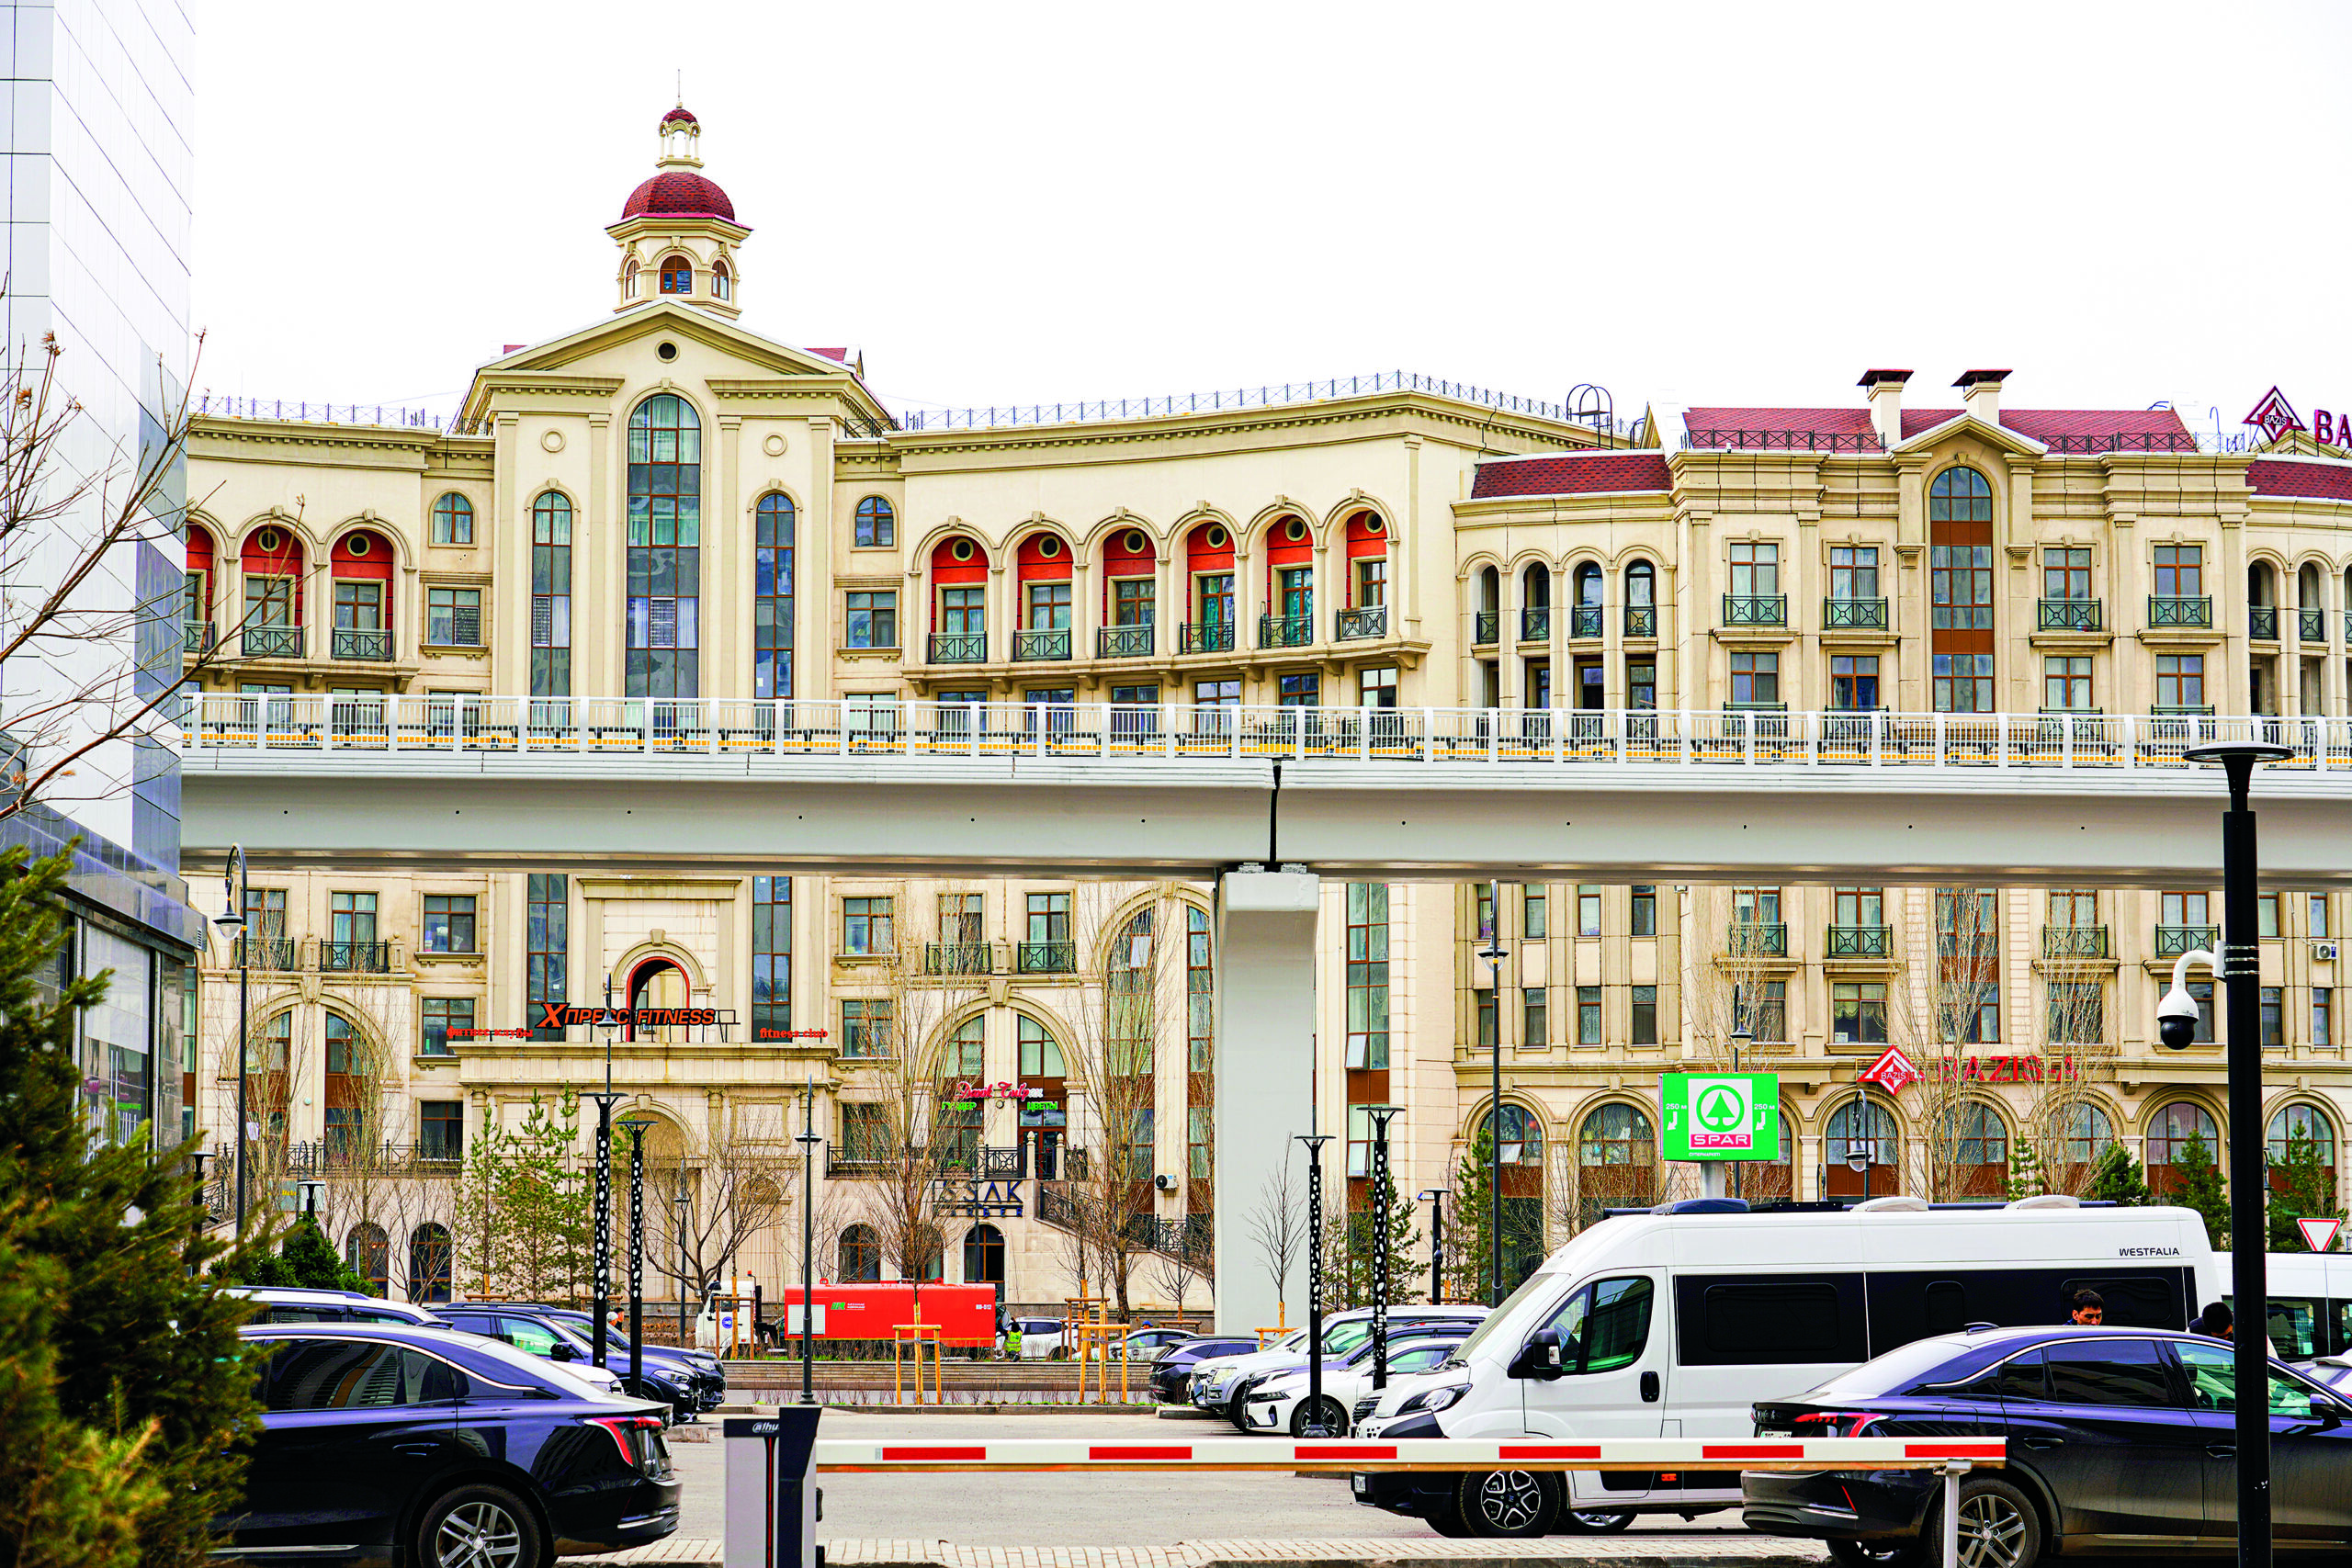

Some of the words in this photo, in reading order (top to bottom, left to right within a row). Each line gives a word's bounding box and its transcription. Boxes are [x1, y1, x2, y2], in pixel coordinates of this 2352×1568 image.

[2265, 414, 2287, 425] BAZIS
[2314, 410, 2352, 448] BA
[637, 1009, 716, 1025] FITNESS
[447, 1025, 490, 1039] фитнес
[493, 1028, 534, 1039] клубы
[759, 1028, 799, 1038] fitness
[802, 1028, 829, 1038] club
[1938, 1055, 2078, 1081] BAZIS-A
[1881, 1071, 1906, 1079] BAZIS
[1026, 1101, 1058, 1111] ЦВЕТЫ
[1694, 1134, 1747, 1145] SPAR
[933, 1207, 1023, 1217] ARBER
[2119, 1247, 2180, 1256] WESTFALIA
